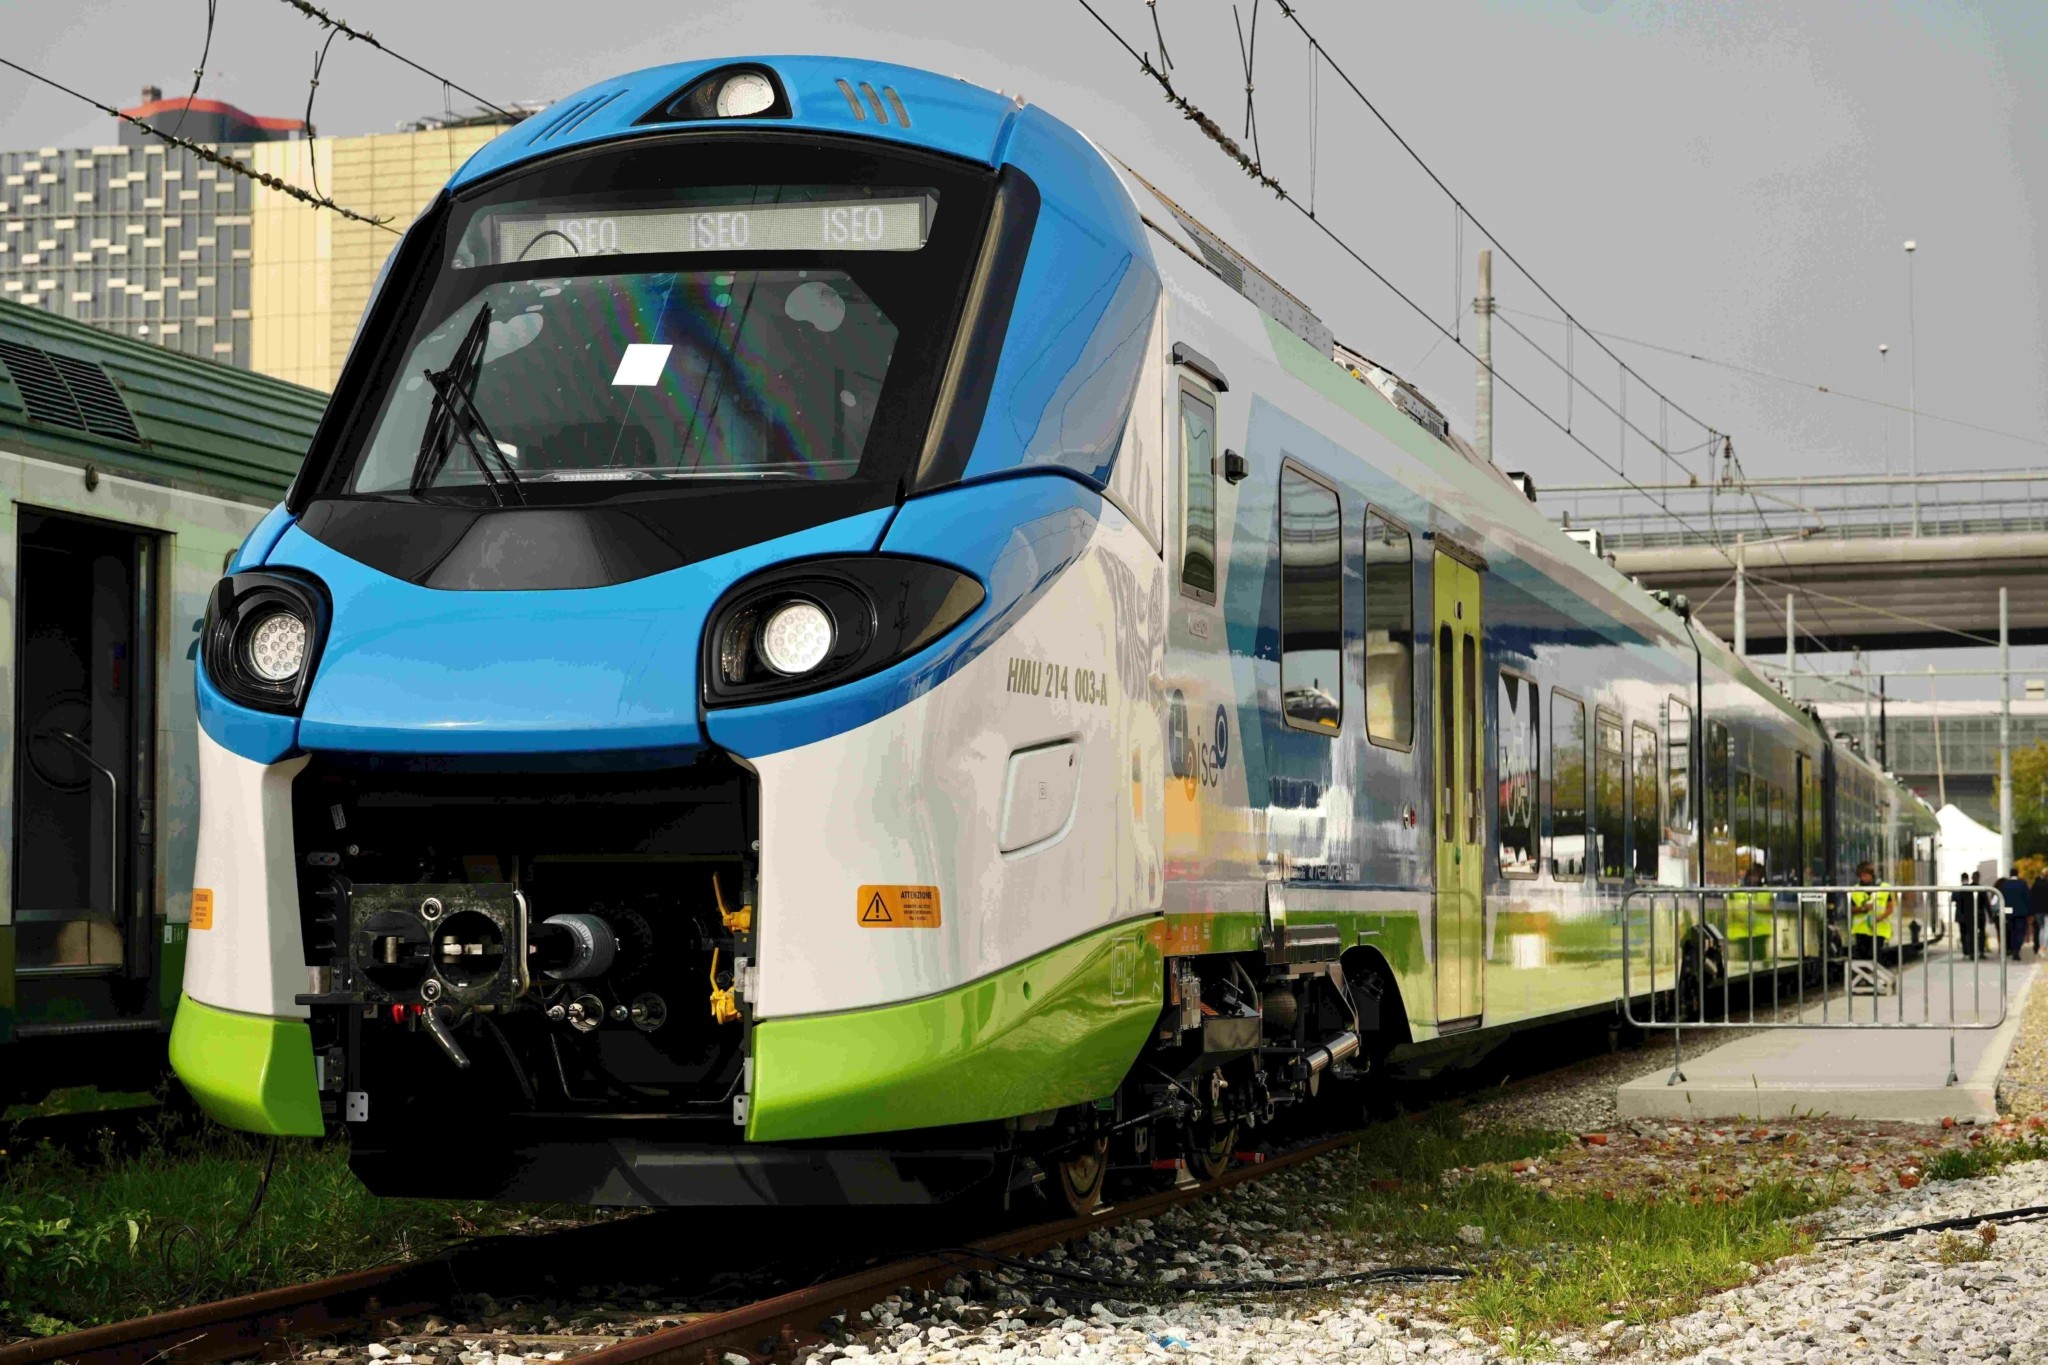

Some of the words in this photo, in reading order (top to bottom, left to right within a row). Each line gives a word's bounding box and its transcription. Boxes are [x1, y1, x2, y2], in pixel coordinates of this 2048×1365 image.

[559, 216, 618, 254] ISEO
[689, 212, 749, 248] ISEO
[823, 206, 884, 242] ISEO
[1007, 657, 1042, 696] HMU
[1045, 663, 1068, 700] 214
[1075, 667, 1107, 706] 003-A
[901, 891, 932, 900] ATTENZIONE
